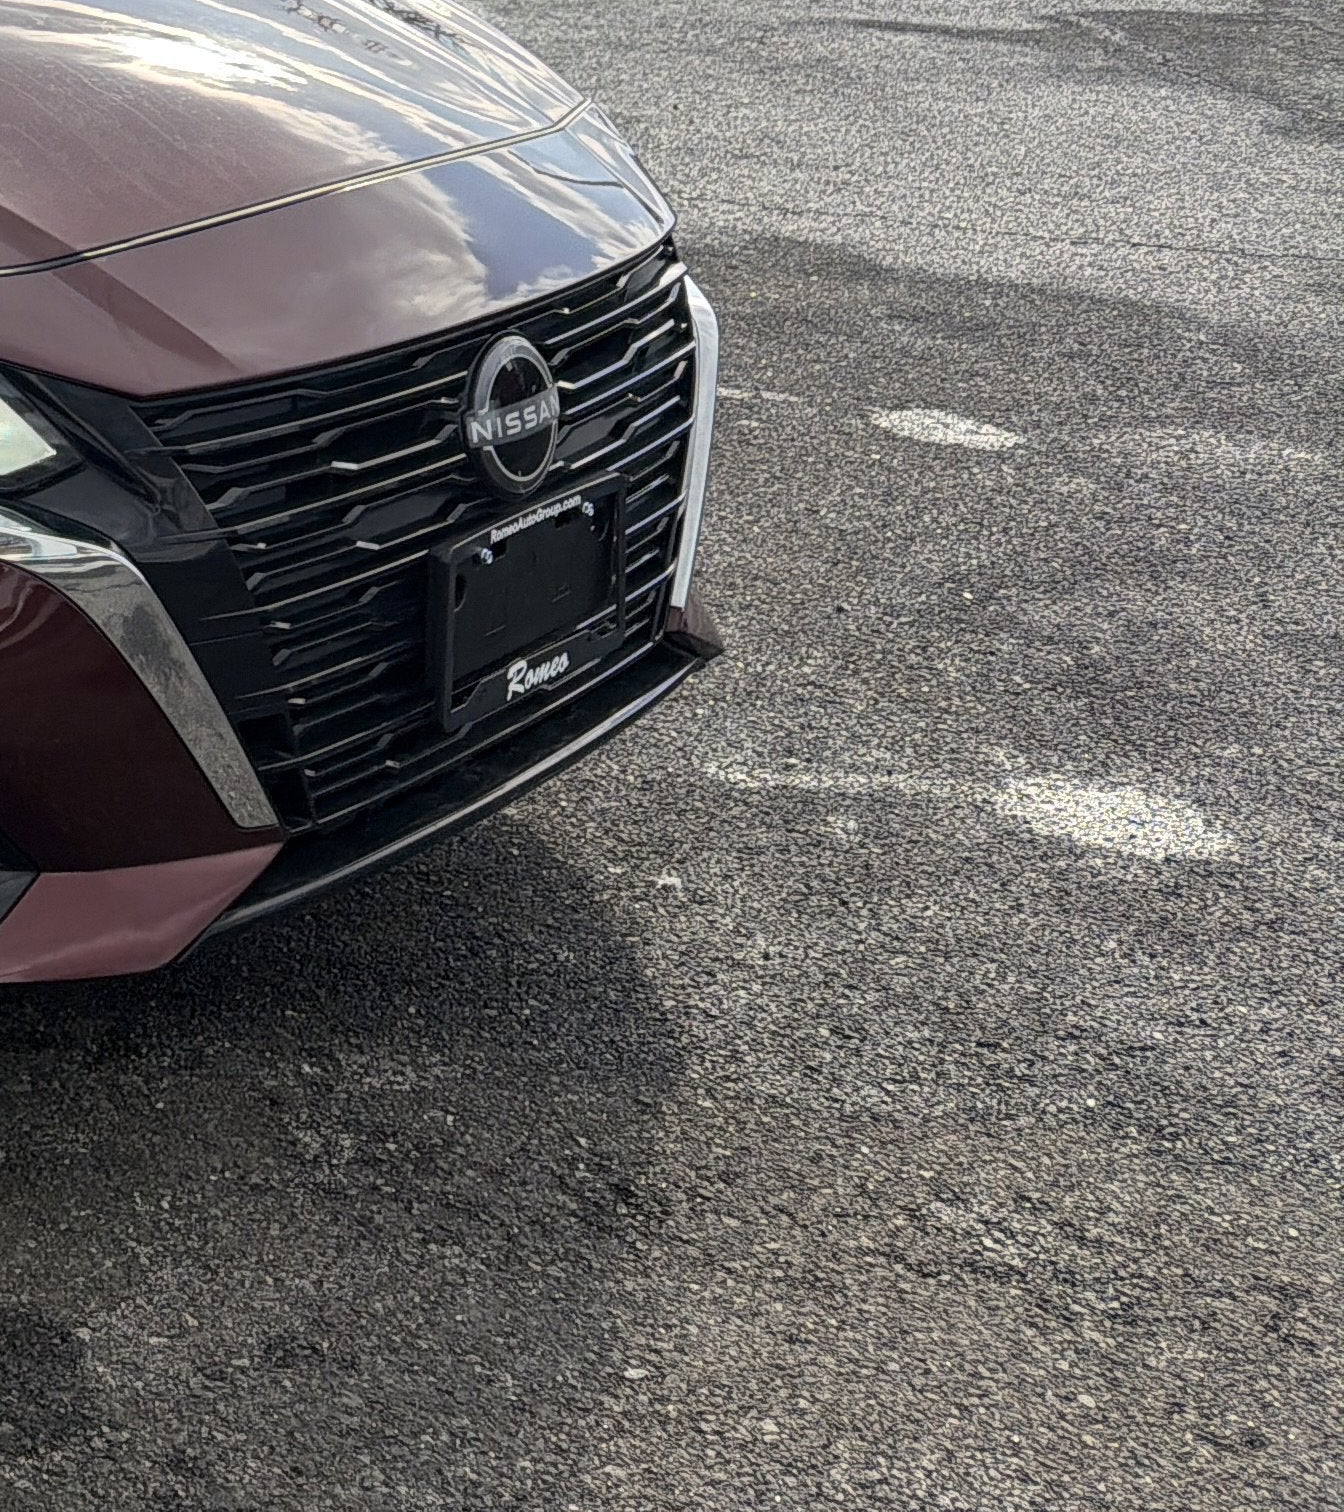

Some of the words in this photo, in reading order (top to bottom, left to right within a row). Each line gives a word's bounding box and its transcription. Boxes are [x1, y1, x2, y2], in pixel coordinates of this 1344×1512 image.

[470, 394, 560, 444] NISSAN
[490, 494, 582, 545] RomeoAutoGroup.com
[506, 651, 570, 702] Romeo
